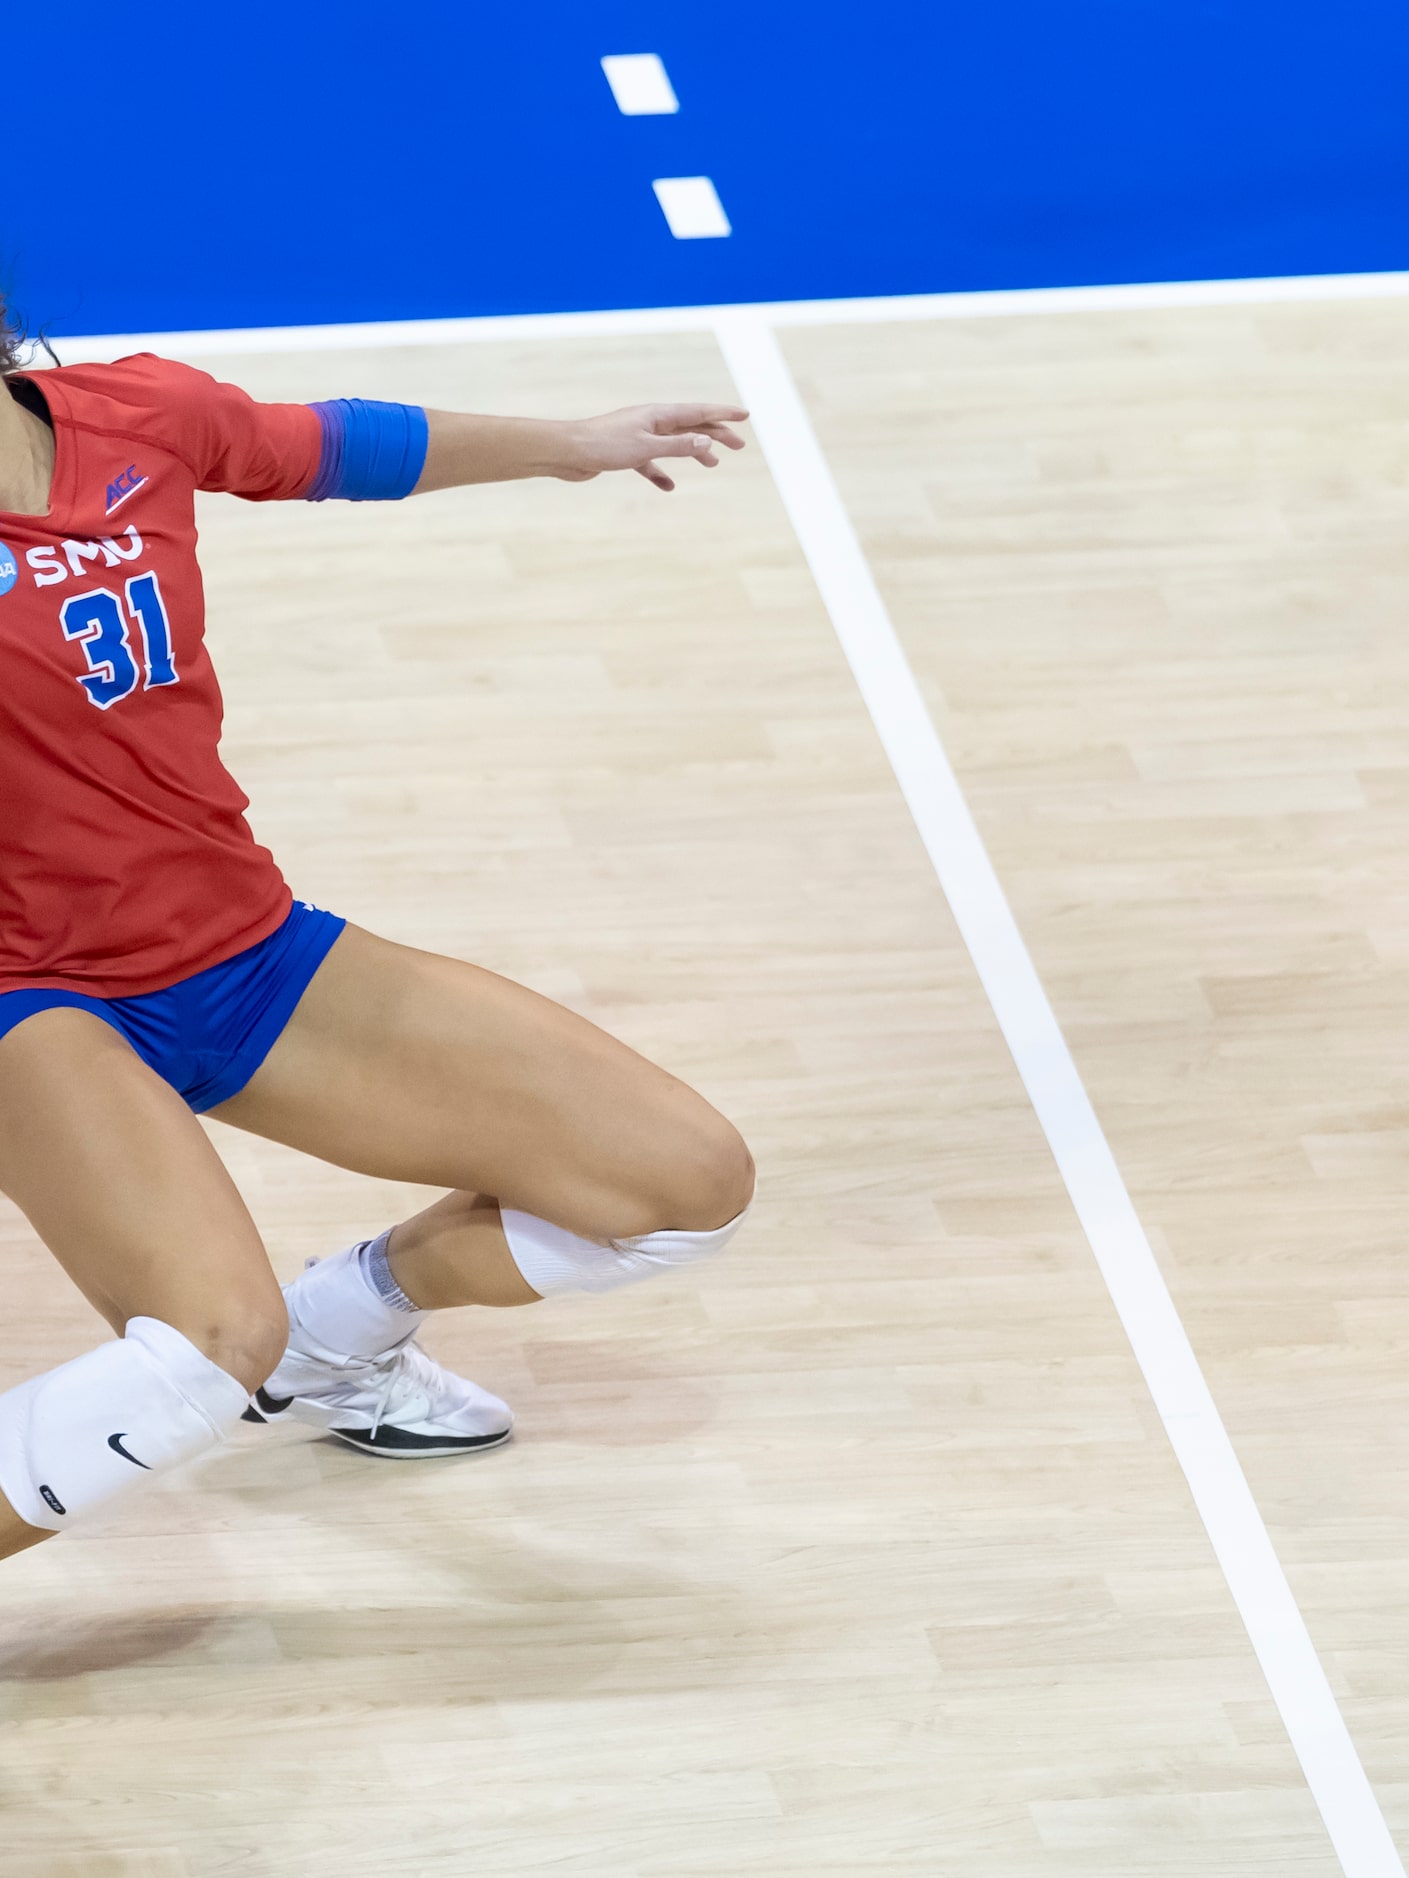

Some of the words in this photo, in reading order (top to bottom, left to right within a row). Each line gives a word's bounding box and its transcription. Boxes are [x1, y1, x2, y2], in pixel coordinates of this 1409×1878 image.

[106, 464, 143, 510] ACC
[25, 524, 143, 588] SMU
[59, 570, 180, 711] 31
